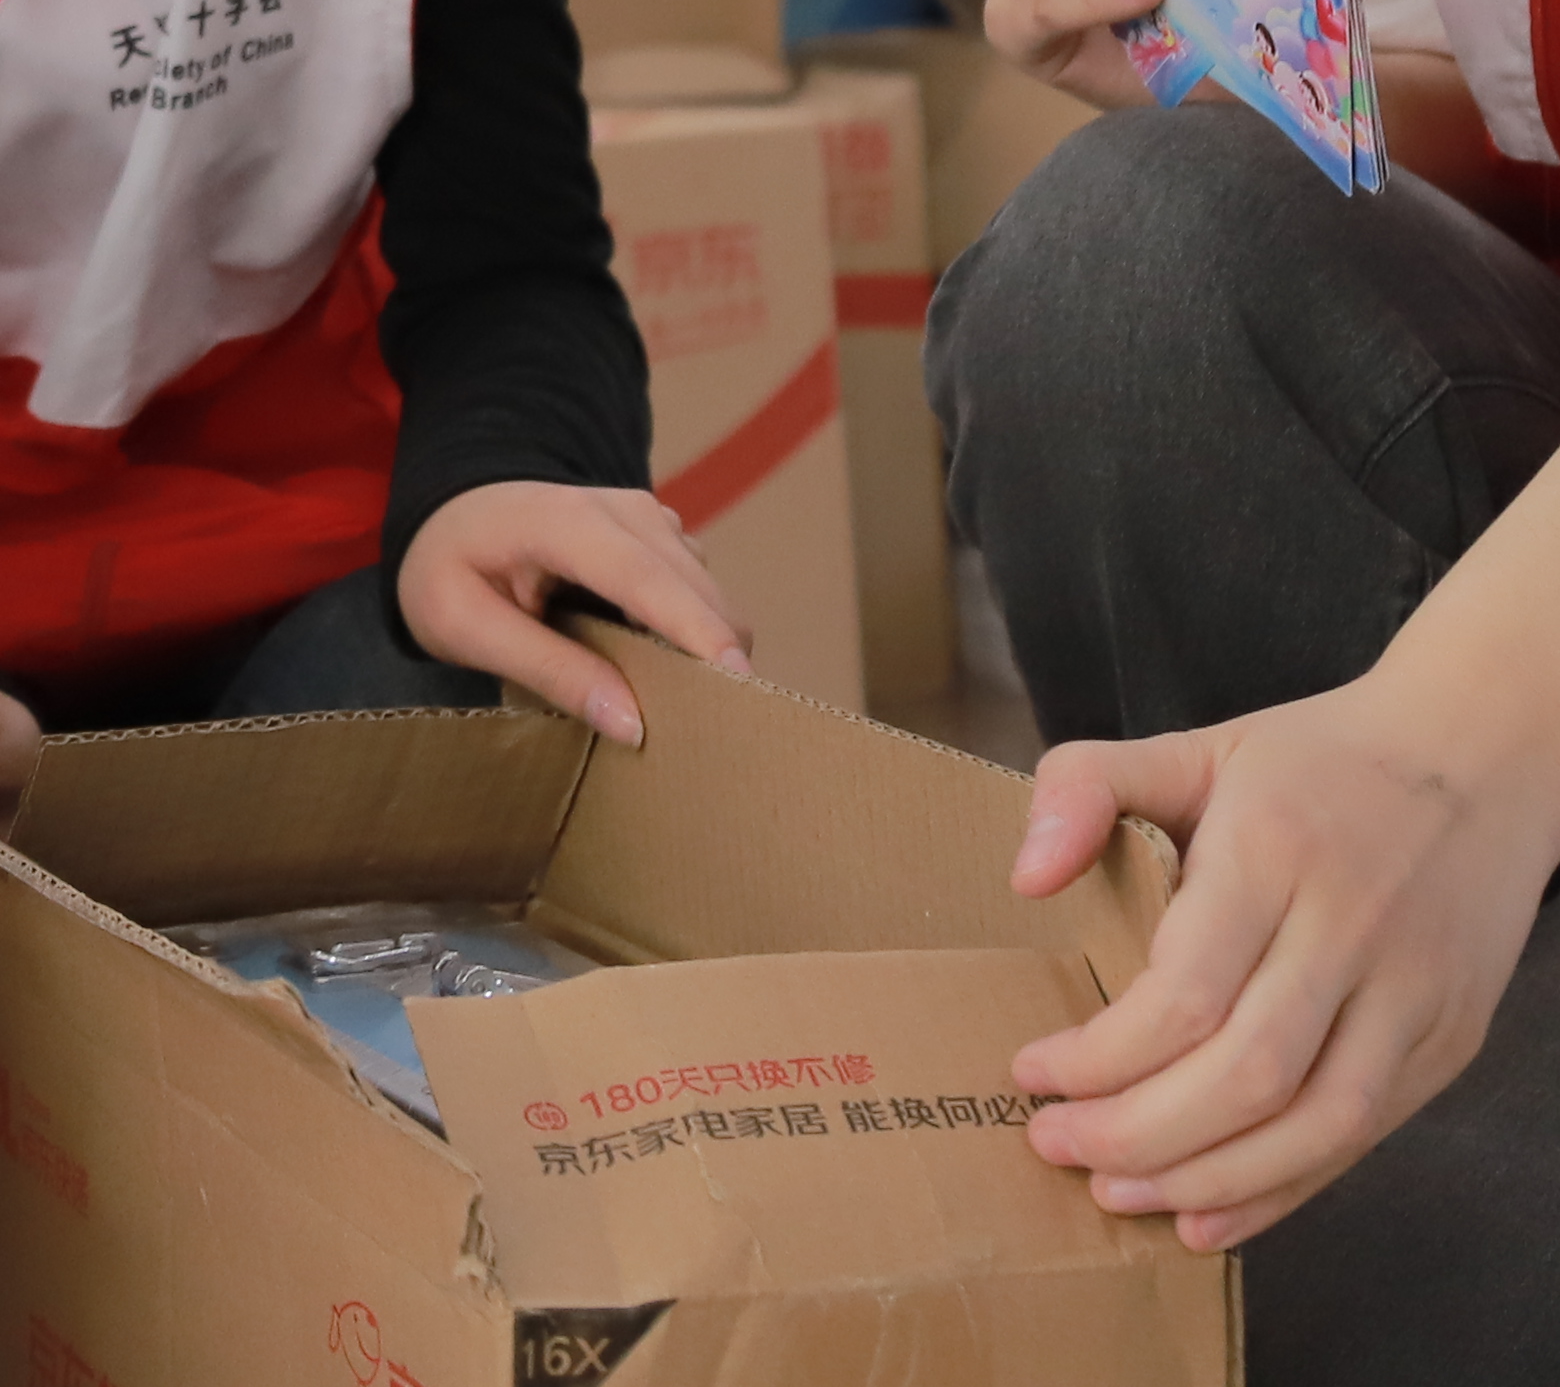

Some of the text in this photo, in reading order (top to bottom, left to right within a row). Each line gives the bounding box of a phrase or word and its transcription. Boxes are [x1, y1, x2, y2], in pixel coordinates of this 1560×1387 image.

[210, 46, 232, 72] of
[241, 31, 294, 63] China
[151, 77, 228, 110] Branch
[579, 1054, 875, 1120] 180天只换不修
[532, 1101, 829, 1177] 京东家电家居
